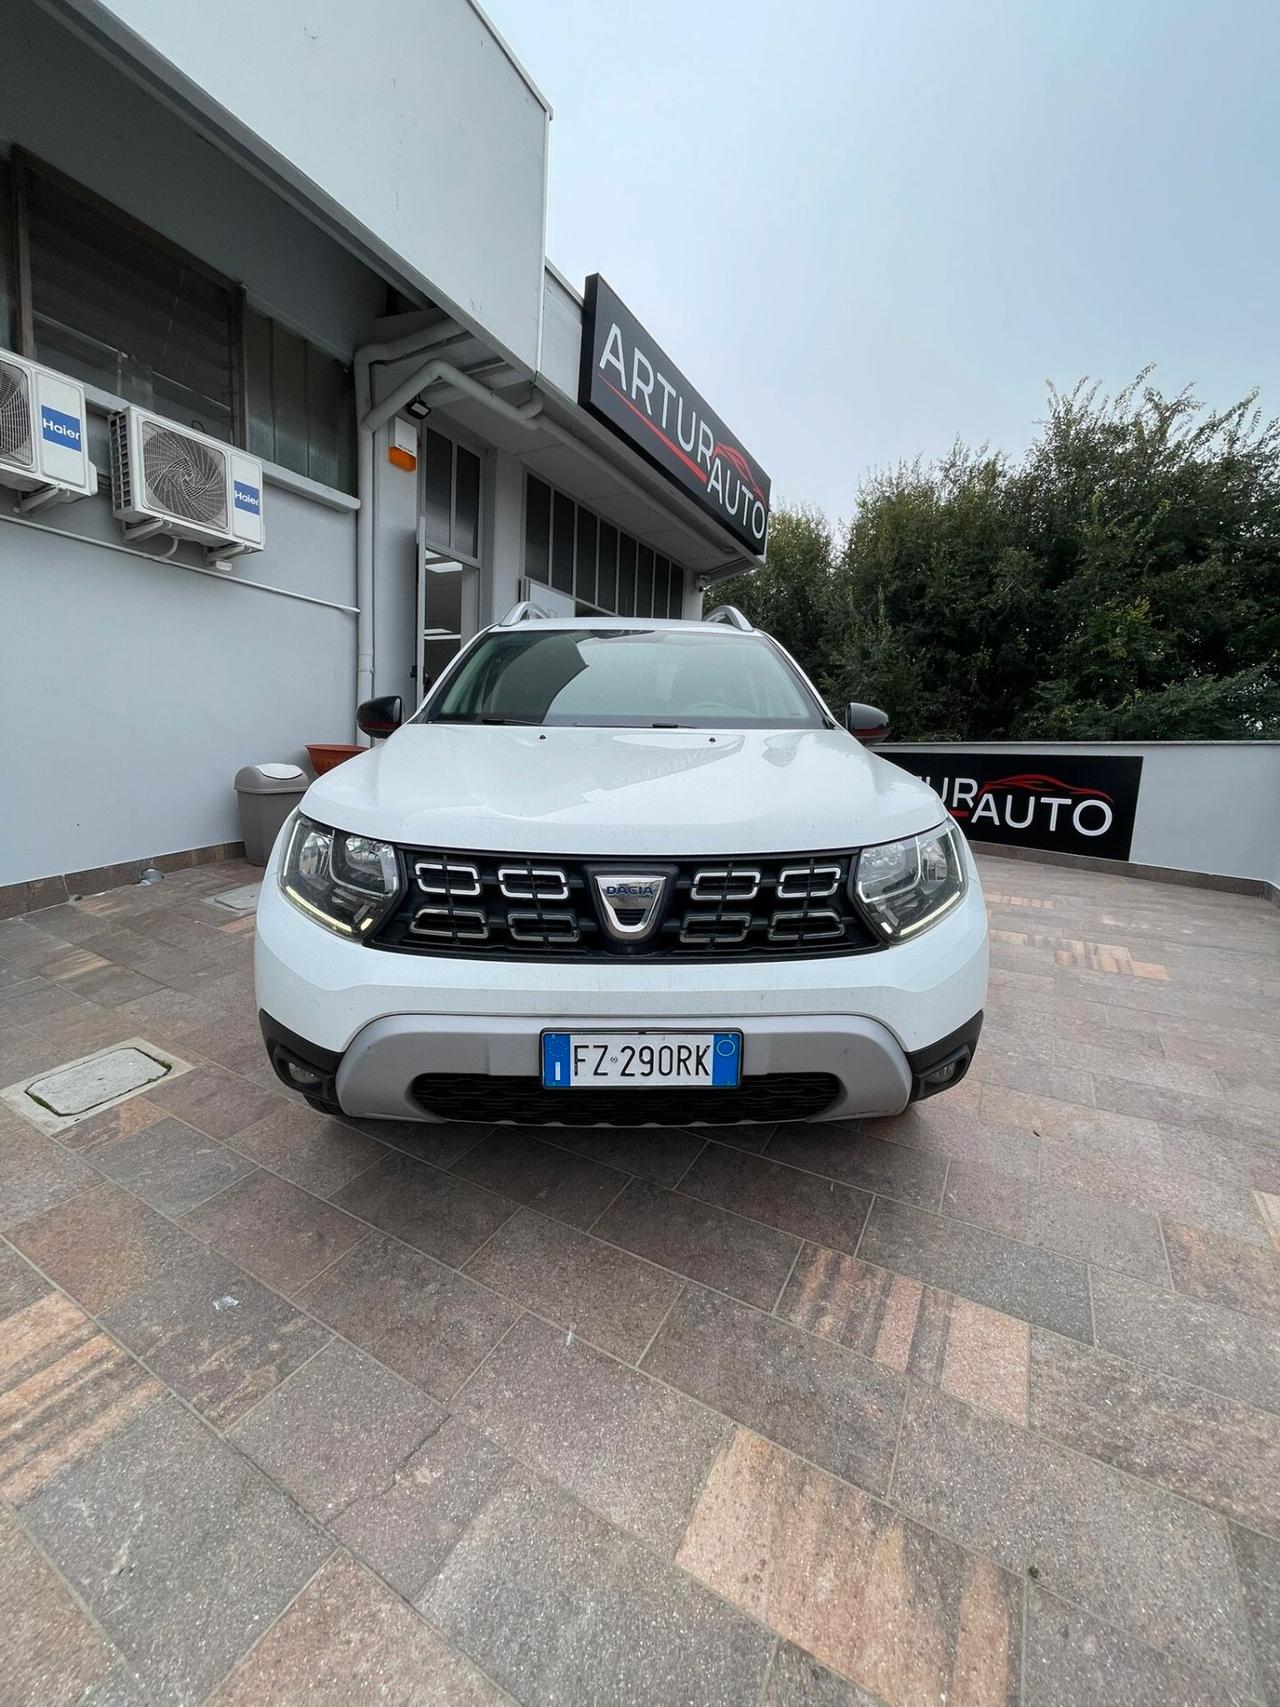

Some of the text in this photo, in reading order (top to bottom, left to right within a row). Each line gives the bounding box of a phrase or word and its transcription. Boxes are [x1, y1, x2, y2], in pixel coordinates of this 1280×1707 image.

[42, 417, 80, 441] Haier
[599, 322, 766, 540] ARTUR AUTO
[234, 489, 260, 506] Haier
[970, 793, 1113, 837] AUTO
[606, 886, 654, 895] DACIA
[573, 1044, 609, 1077] FZ
[620, 1044, 712, 1077] 290RK
